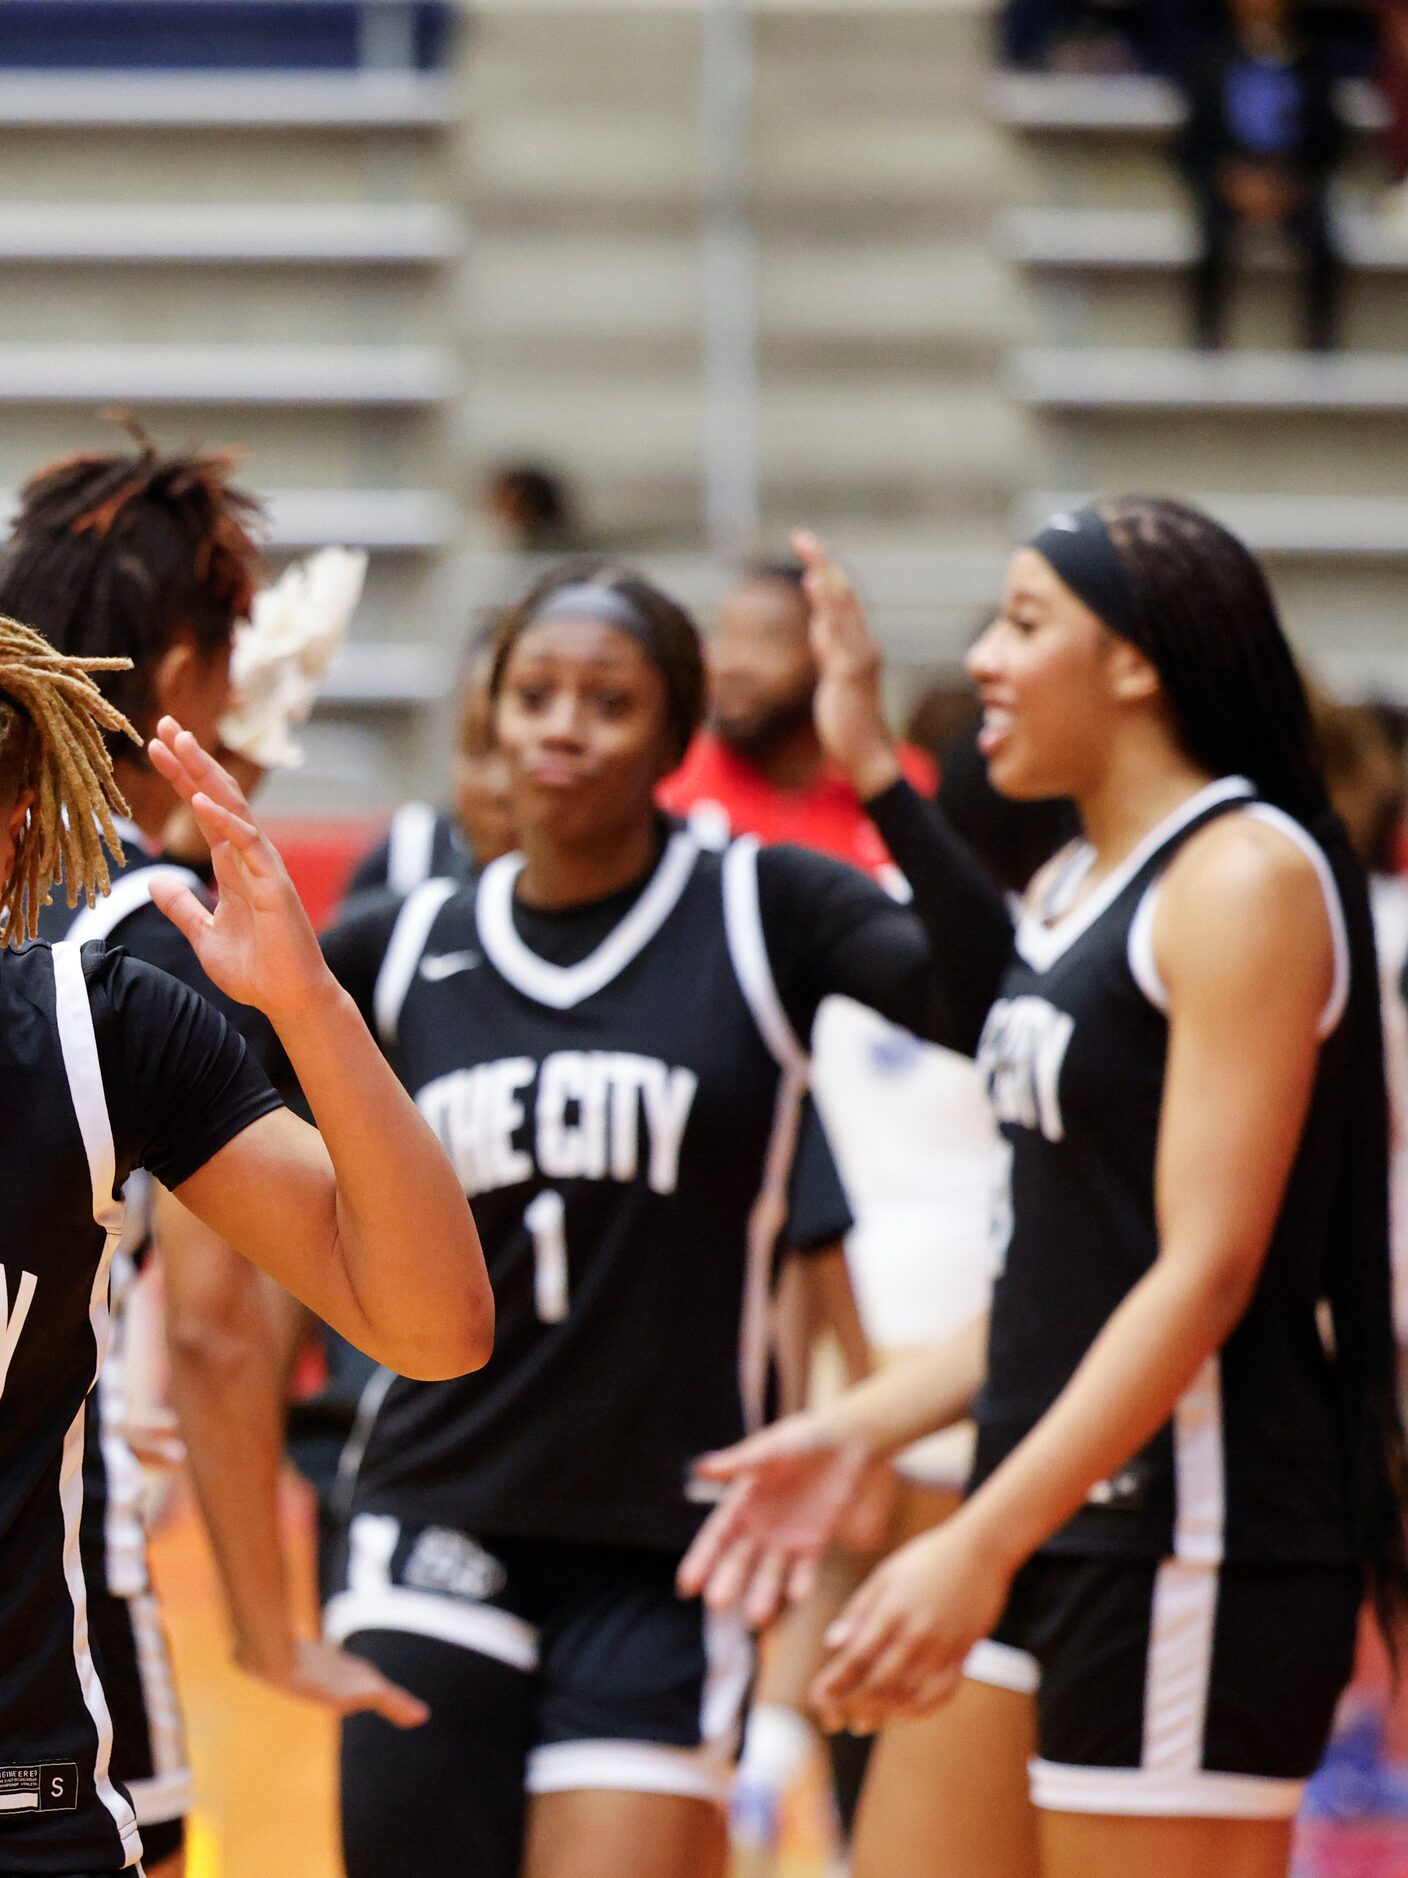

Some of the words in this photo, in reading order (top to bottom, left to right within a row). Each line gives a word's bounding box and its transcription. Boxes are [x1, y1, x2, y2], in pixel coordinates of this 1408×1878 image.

[535, 1049, 698, 1196] CITY
[523, 1190, 570, 1324] 1
[50, 1776, 64, 1798] S
